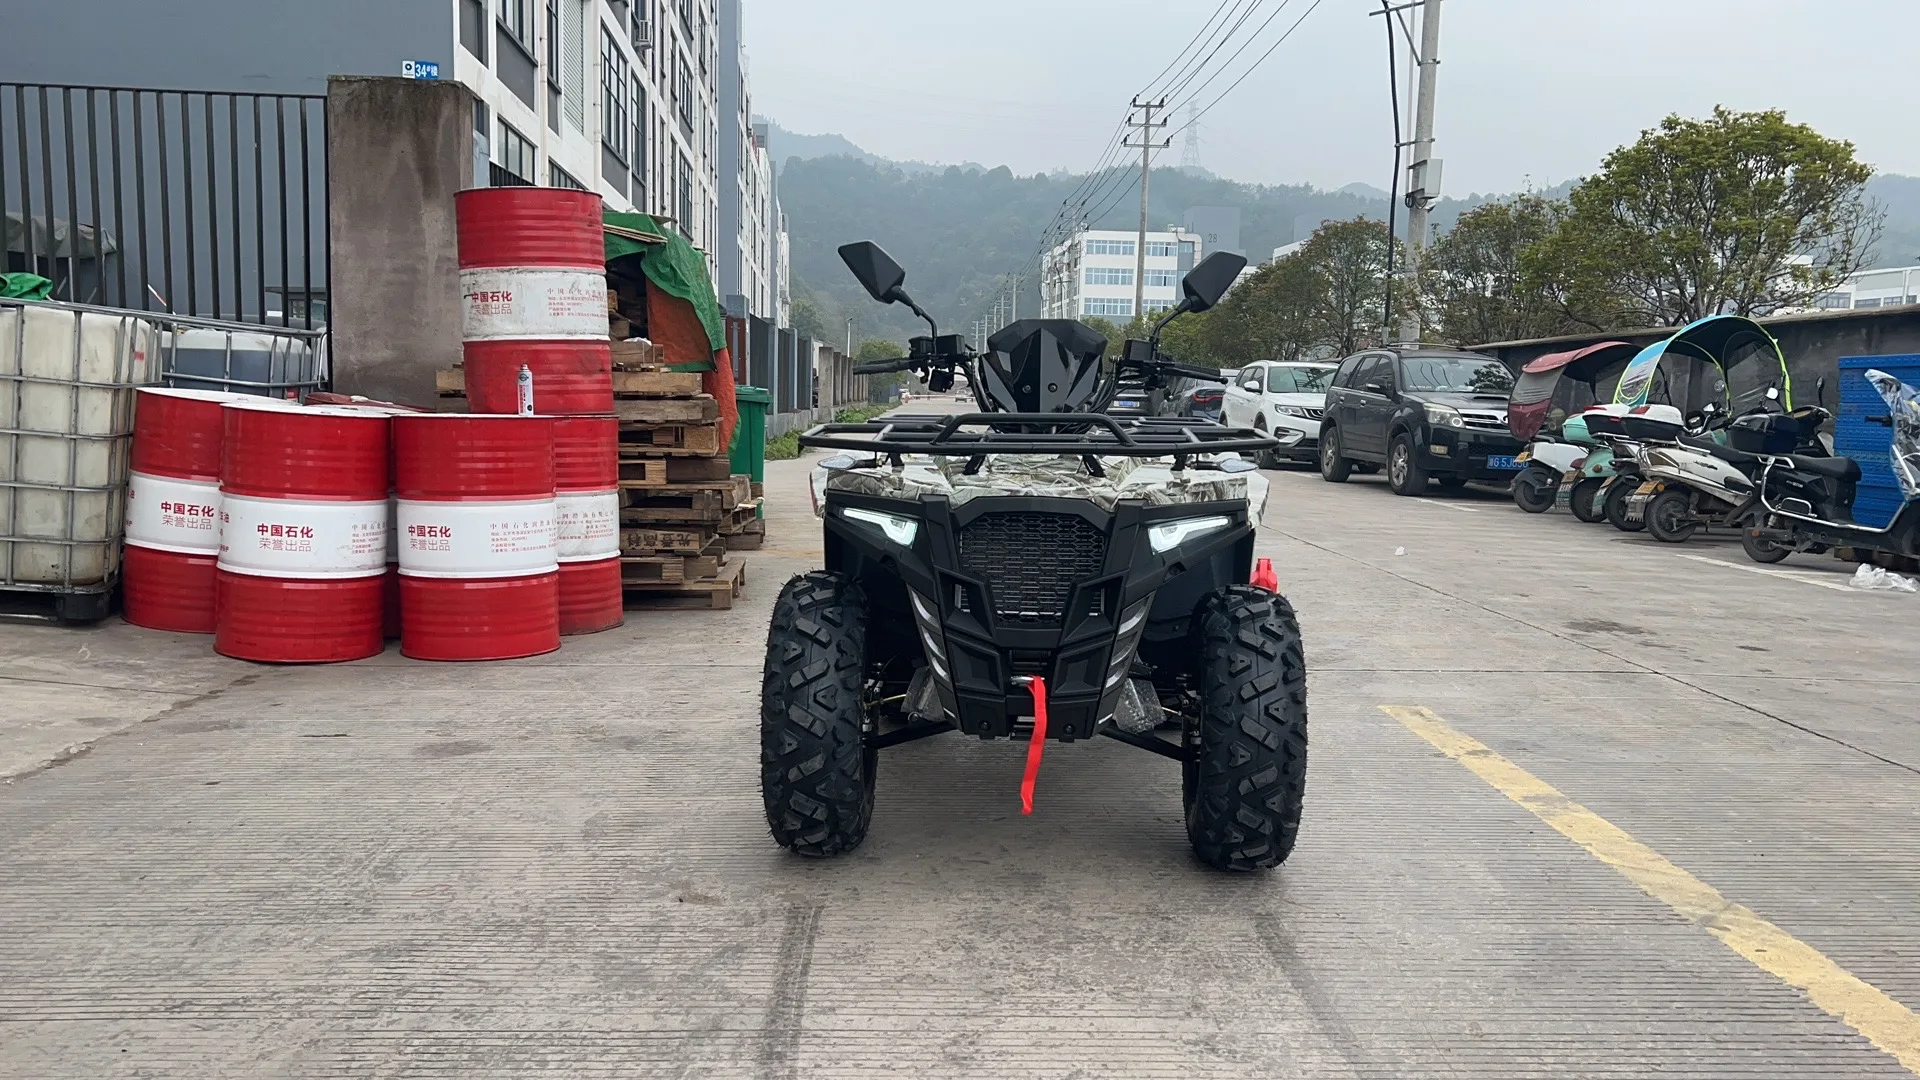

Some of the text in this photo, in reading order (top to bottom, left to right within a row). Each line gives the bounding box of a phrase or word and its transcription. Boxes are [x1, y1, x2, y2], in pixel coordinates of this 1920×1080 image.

[1208, 233, 1218, 243] 28
[471, 291, 512, 303] 中国石化
[160, 501, 214, 518] 中国石化
[162, 514, 212, 530] 荣誉出品
[257, 523, 314, 539] 中国石化
[408, 525, 452, 538] 中国石化
[259, 537, 312, 553] 荣誉出品
[410, 538, 451, 551] 荣誉出品
